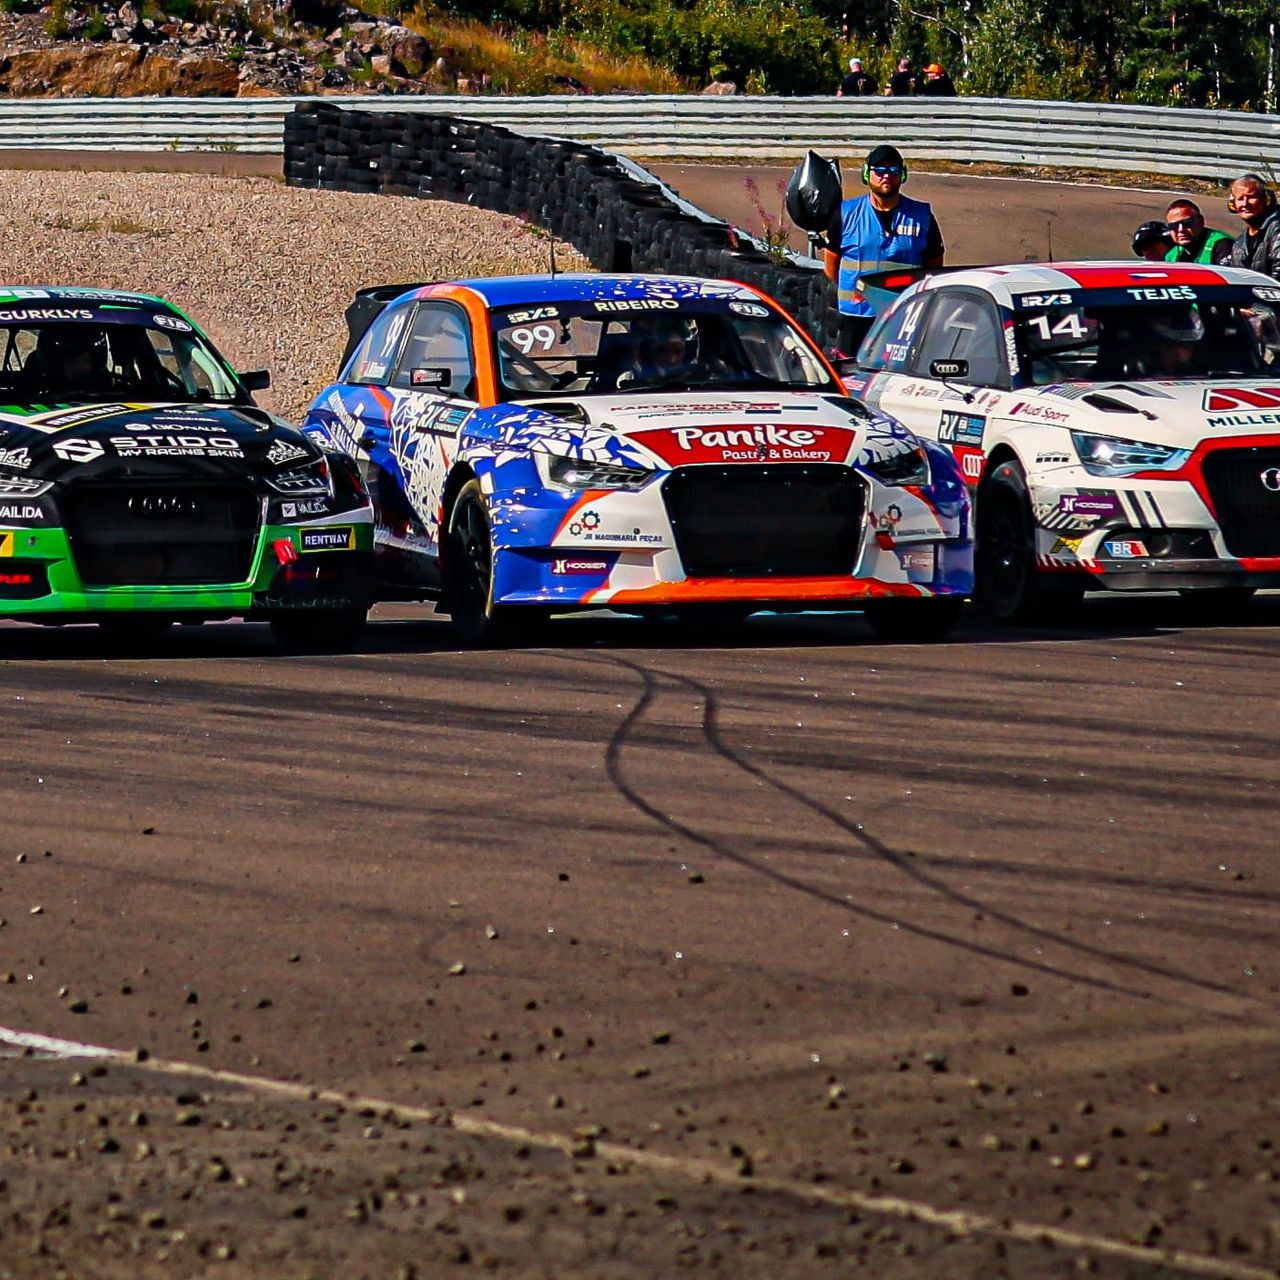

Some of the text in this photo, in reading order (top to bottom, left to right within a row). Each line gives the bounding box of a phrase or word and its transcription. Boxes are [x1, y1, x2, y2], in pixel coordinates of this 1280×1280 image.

[1127, 286, 1197, 300] TEJEŠ
[594, 300, 679, 312] RIBEIRO
[731, 303, 767, 317] FIA
[897, 302, 924, 340] 14
[1028, 314, 1088, 339] 14
[511, 325, 556, 354] 99
[1022, 403, 1070, 422] Audi Sport
[109, 436, 239, 449] STIDO
[117, 448, 245, 458] MY RACING SKIN
[723, 449, 831, 462] Pastry & Bakery
[305, 535, 347, 546] RENTWAY
